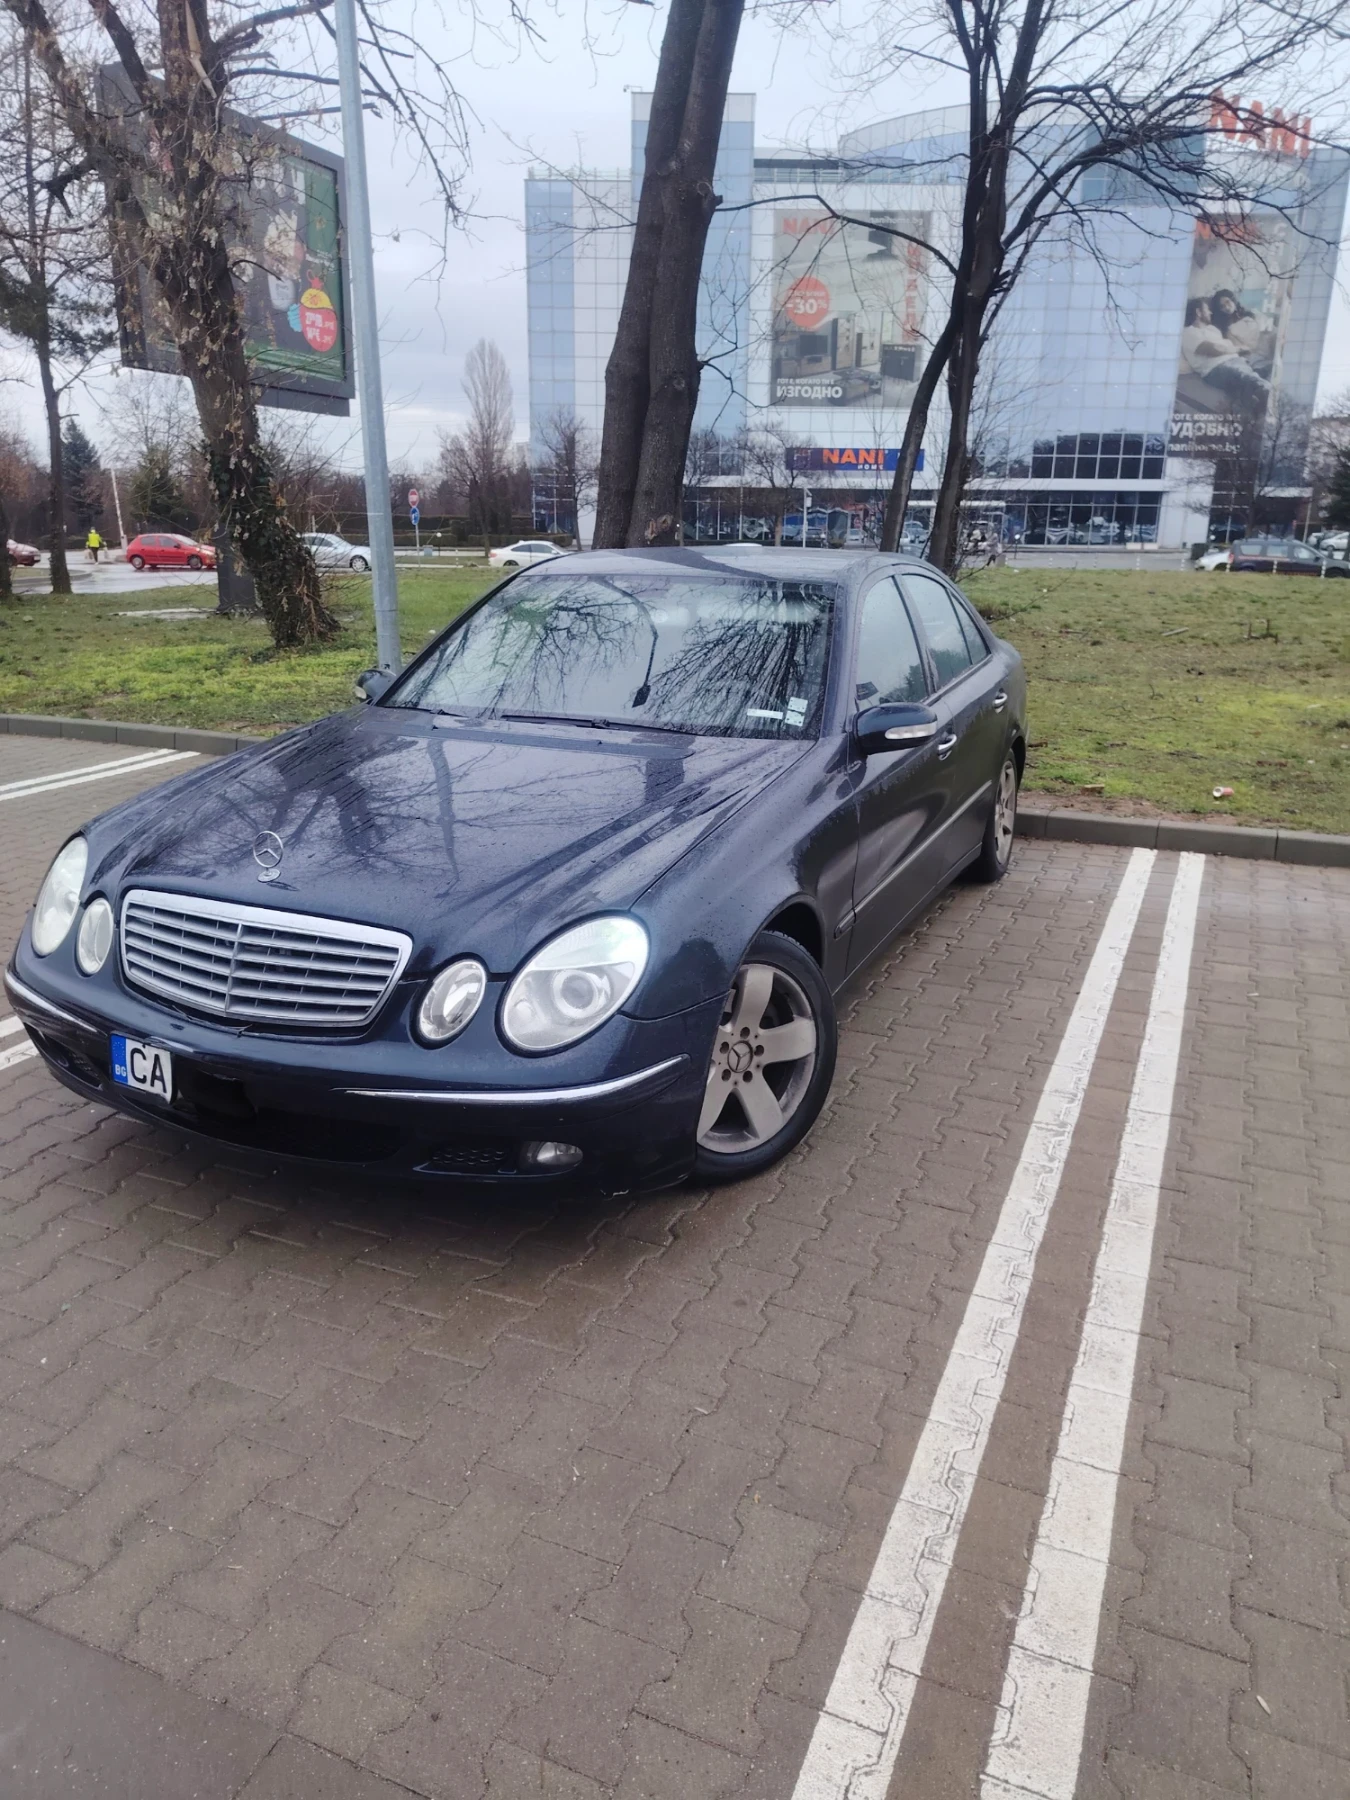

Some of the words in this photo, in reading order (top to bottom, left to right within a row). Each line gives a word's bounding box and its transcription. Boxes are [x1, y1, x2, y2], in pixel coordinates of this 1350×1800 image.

[776, 385, 843, 400] ИЗГОДНО
[1171, 422, 1243, 439] УДОБНО
[822, 448, 884, 464] NANI
[115, 1064, 127, 1077] BG
[130, 1047, 167, 1094] CA
